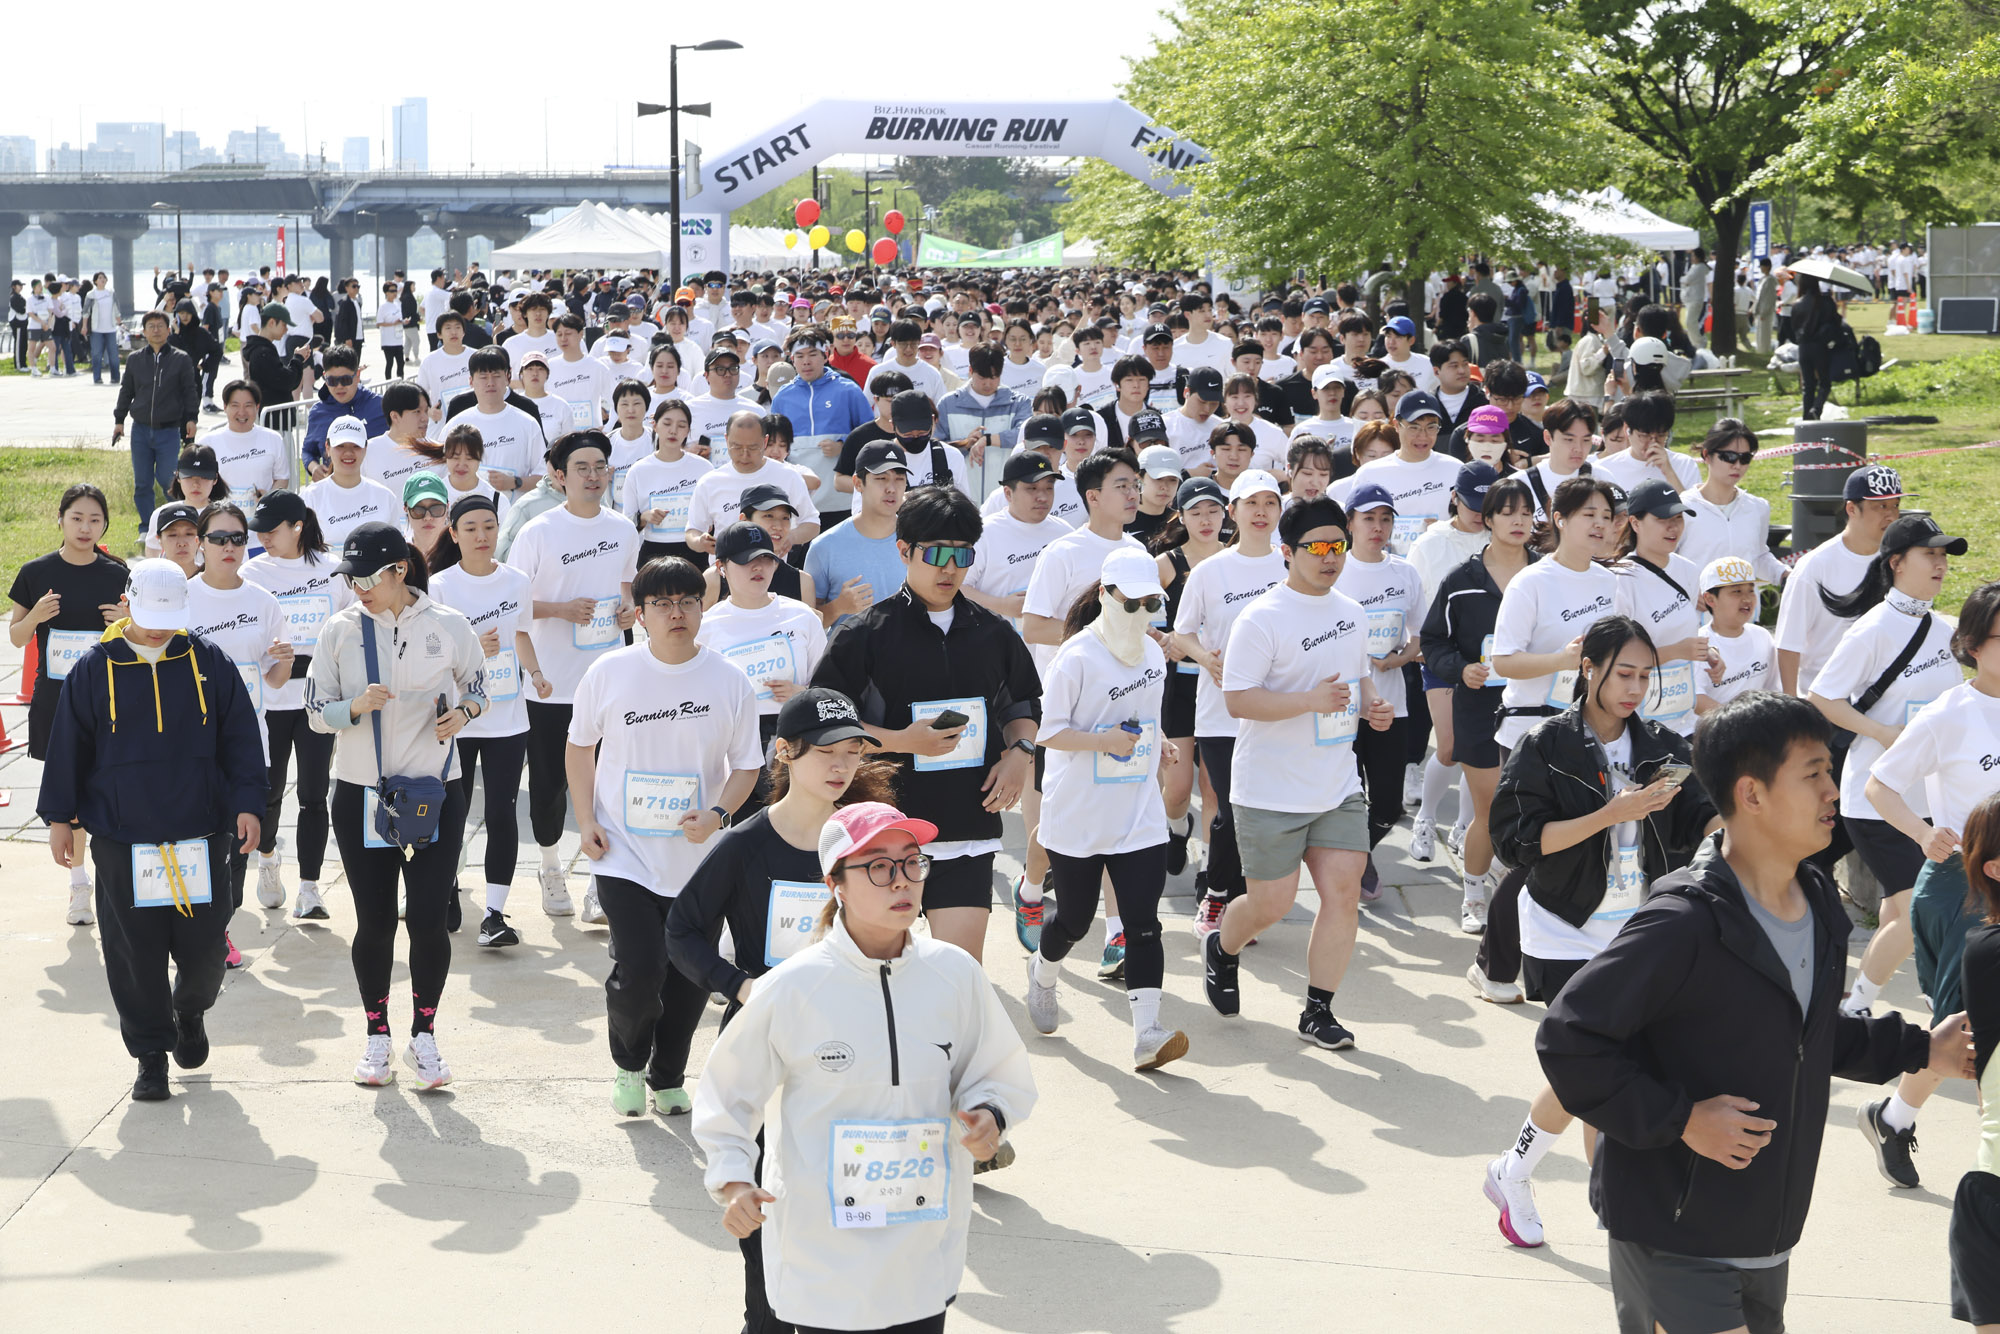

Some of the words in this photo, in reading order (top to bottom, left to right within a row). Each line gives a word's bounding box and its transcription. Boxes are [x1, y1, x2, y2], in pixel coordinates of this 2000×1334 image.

[865, 116, 998, 142] BURNING
[1002, 118, 1068, 142] RUN
[714, 123, 811, 194] START
[440, 371, 462, 383] Burning
[554, 379, 577, 388] Burning
[577, 374, 590, 383] Run
[1026, 378, 1038, 387] Run
[1099, 384, 1113, 392] Run
[1475, 414, 1498, 423] HOKA
[497, 435, 515, 446] Run
[220, 452, 250, 465] Burning
[249, 447, 266, 457] Run
[383, 466, 414, 480] Burning
[679, 479, 697, 489] Run
[1422, 481, 1444, 491] Run
[328, 509, 361, 525] Burning
[360, 503, 379, 515] Run
[1059, 502, 1078, 514] Run
[561, 547, 598, 565] Burning
[597, 540, 619, 553] Run
[306, 578, 330, 590] Run
[1384, 586, 1406, 598] Run
[499, 600, 518, 613] Run
[1561, 603, 1598, 622] Burning
[1595, 595, 1612, 609] Run
[1651, 602, 1681, 623] Burning
[235, 613, 258, 625] Run
[290, 612, 326, 624] 8437
[1302, 630, 1338, 652] Burning
[1336, 620, 1356, 635] Run
[753, 644, 766, 652] RUN
[746, 656, 786, 677] 8270
[1750, 660, 1769, 677] Run
[1903, 656, 1940, 678] Burning
[1562, 675, 1572, 684] W
[1108, 676, 1147, 701] Burning
[1661, 683, 1688, 699] 8529
[624, 707, 679, 726] Burning
[679, 701, 711, 716] Run
[632, 776, 660, 784] BURNING
[632, 796, 643, 806] M
[646, 796, 691, 811] 7189
[142, 869, 153, 878] M
[780, 890, 817, 899] BURNING
[780, 916, 795, 929] W
[842, 1129, 888, 1140] BURNING
[889, 1129, 909, 1139] RUN
[843, 1163, 862, 1177] W
[864, 1156, 935, 1182] 8526
[845, 1211, 872, 1221] B-96
